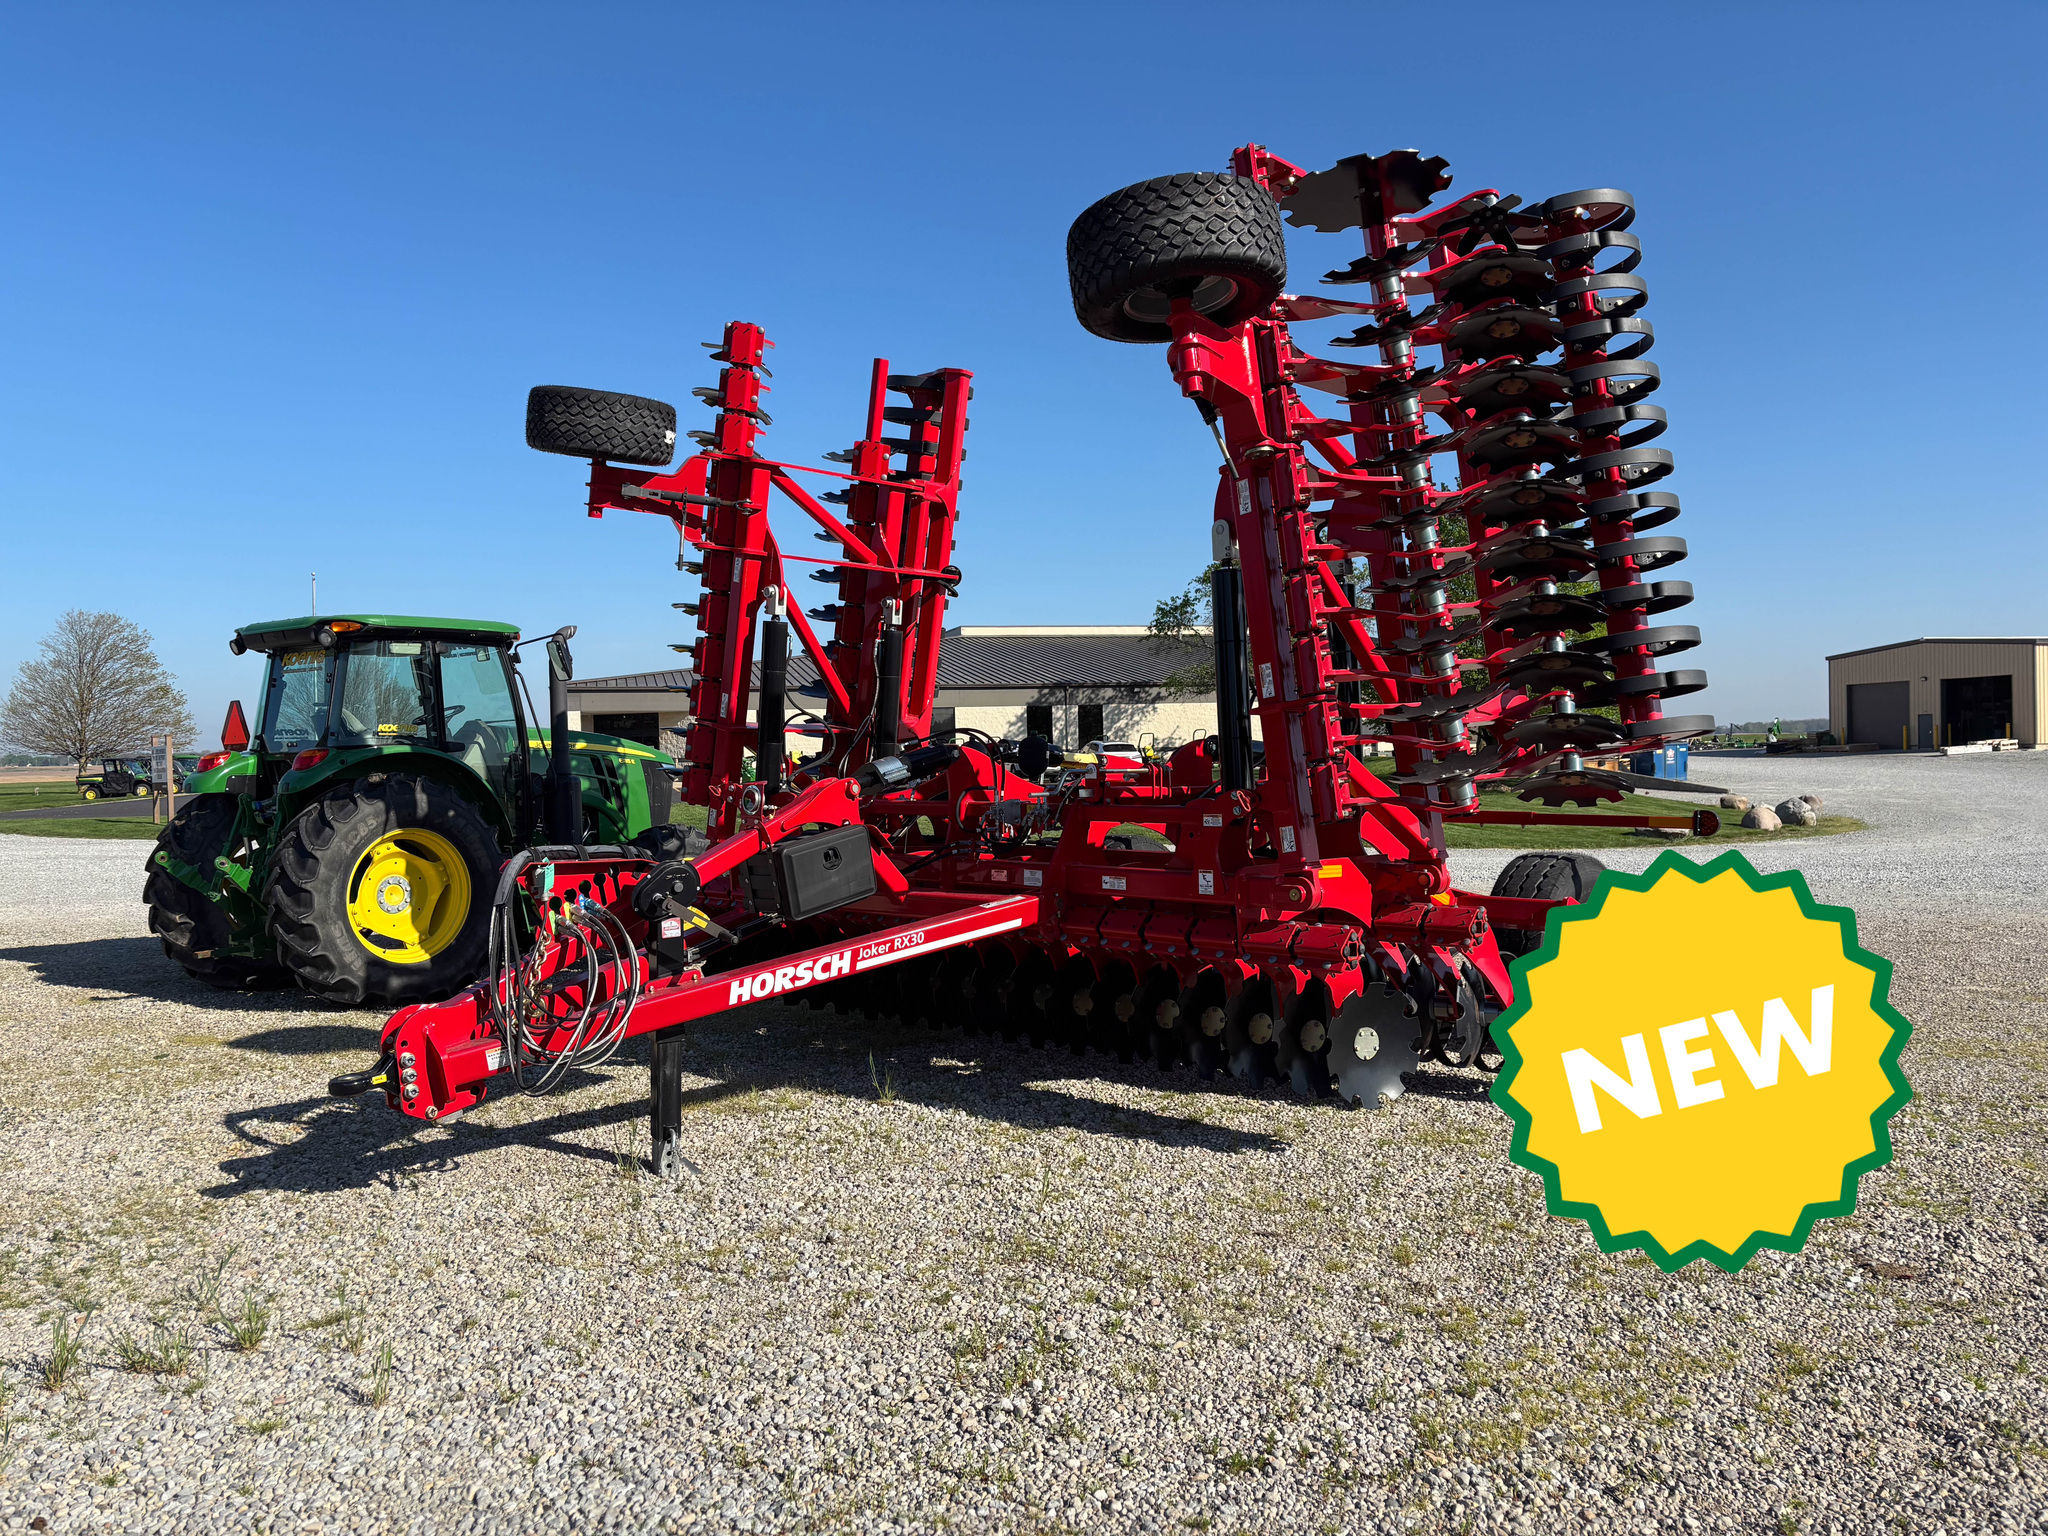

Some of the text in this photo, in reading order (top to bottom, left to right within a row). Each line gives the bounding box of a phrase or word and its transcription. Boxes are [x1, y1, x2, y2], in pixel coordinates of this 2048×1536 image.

[728, 931, 926, 1006] HORSCH Joker RX30
